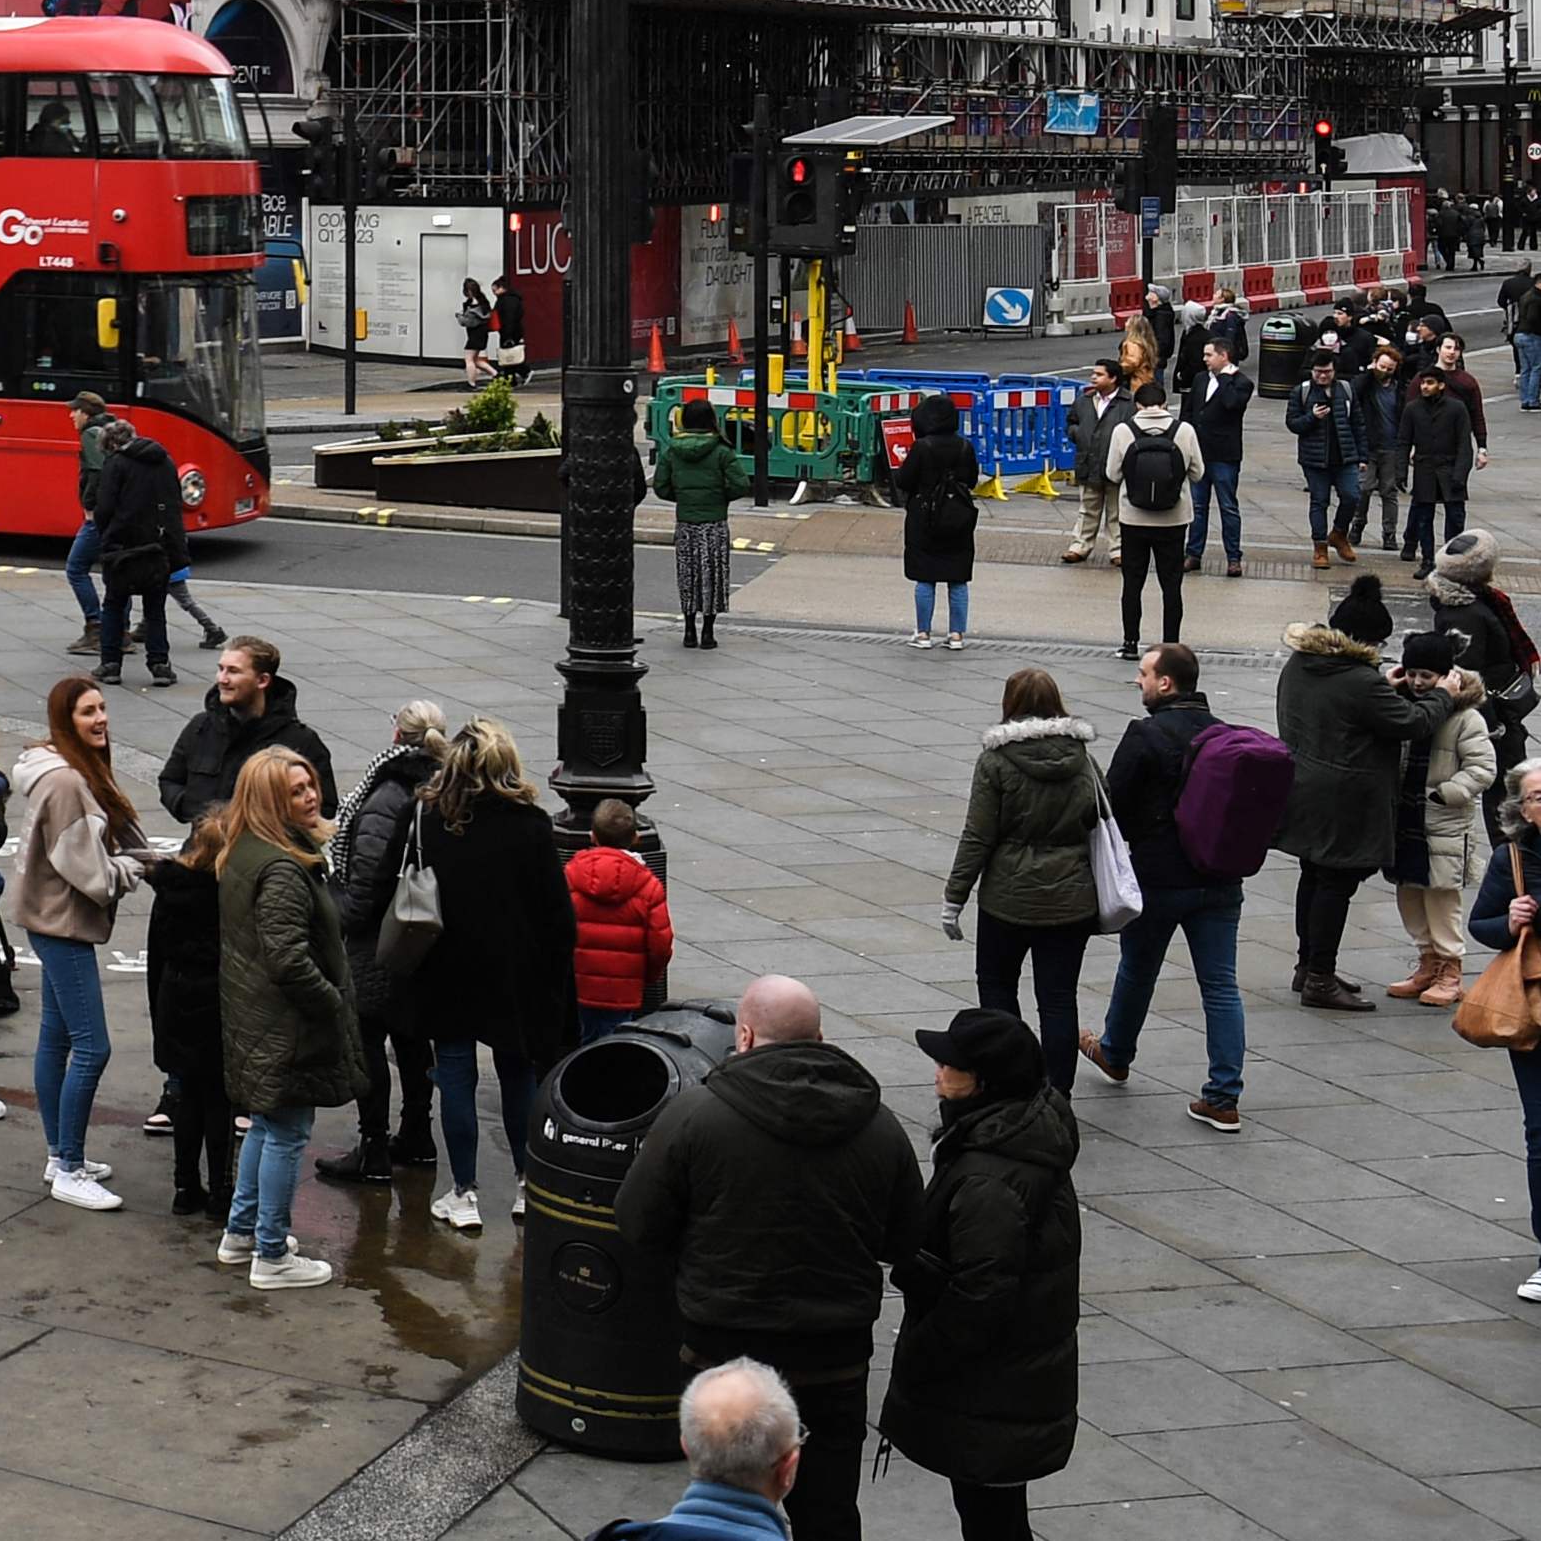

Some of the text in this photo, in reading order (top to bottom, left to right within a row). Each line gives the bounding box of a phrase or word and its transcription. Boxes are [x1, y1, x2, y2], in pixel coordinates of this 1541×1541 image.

[318, 228, 374, 244] Q1 223
[515, 222, 572, 274] LUC
[562, 1133, 599, 1147] general
